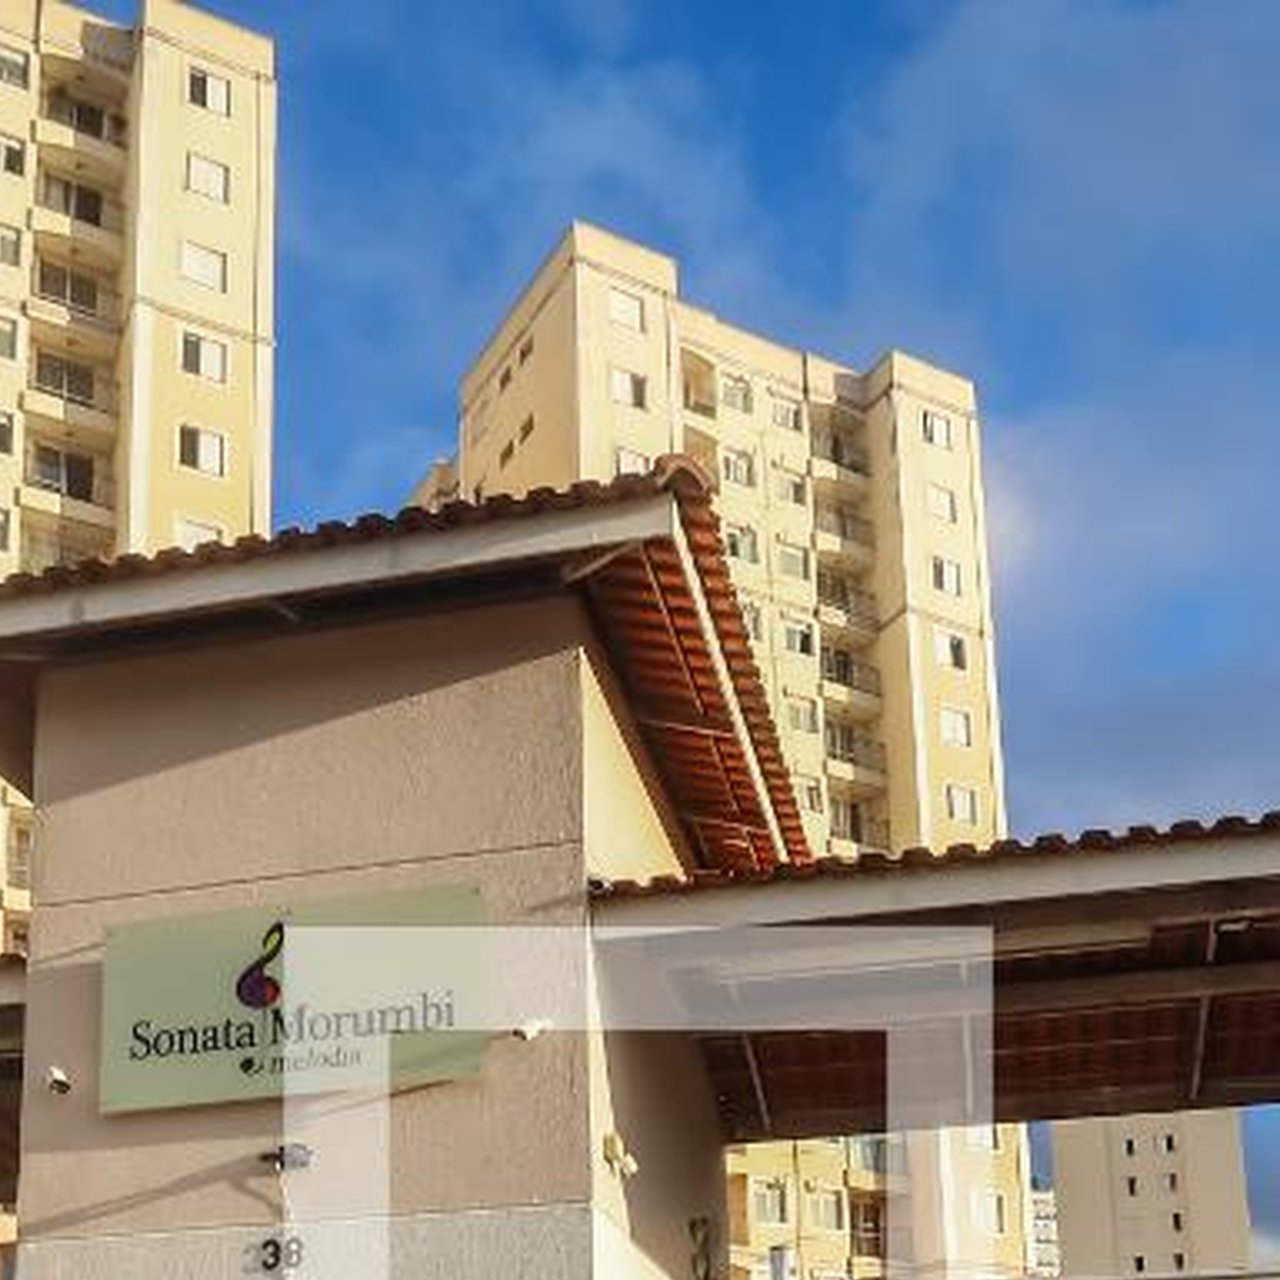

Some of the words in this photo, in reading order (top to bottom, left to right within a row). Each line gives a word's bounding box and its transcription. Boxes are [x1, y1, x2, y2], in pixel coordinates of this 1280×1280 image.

[129, 1018, 257, 1060] Sonata
[270, 990, 456, 1043] Morumbi
[262, 1238, 304, 1271] 38
